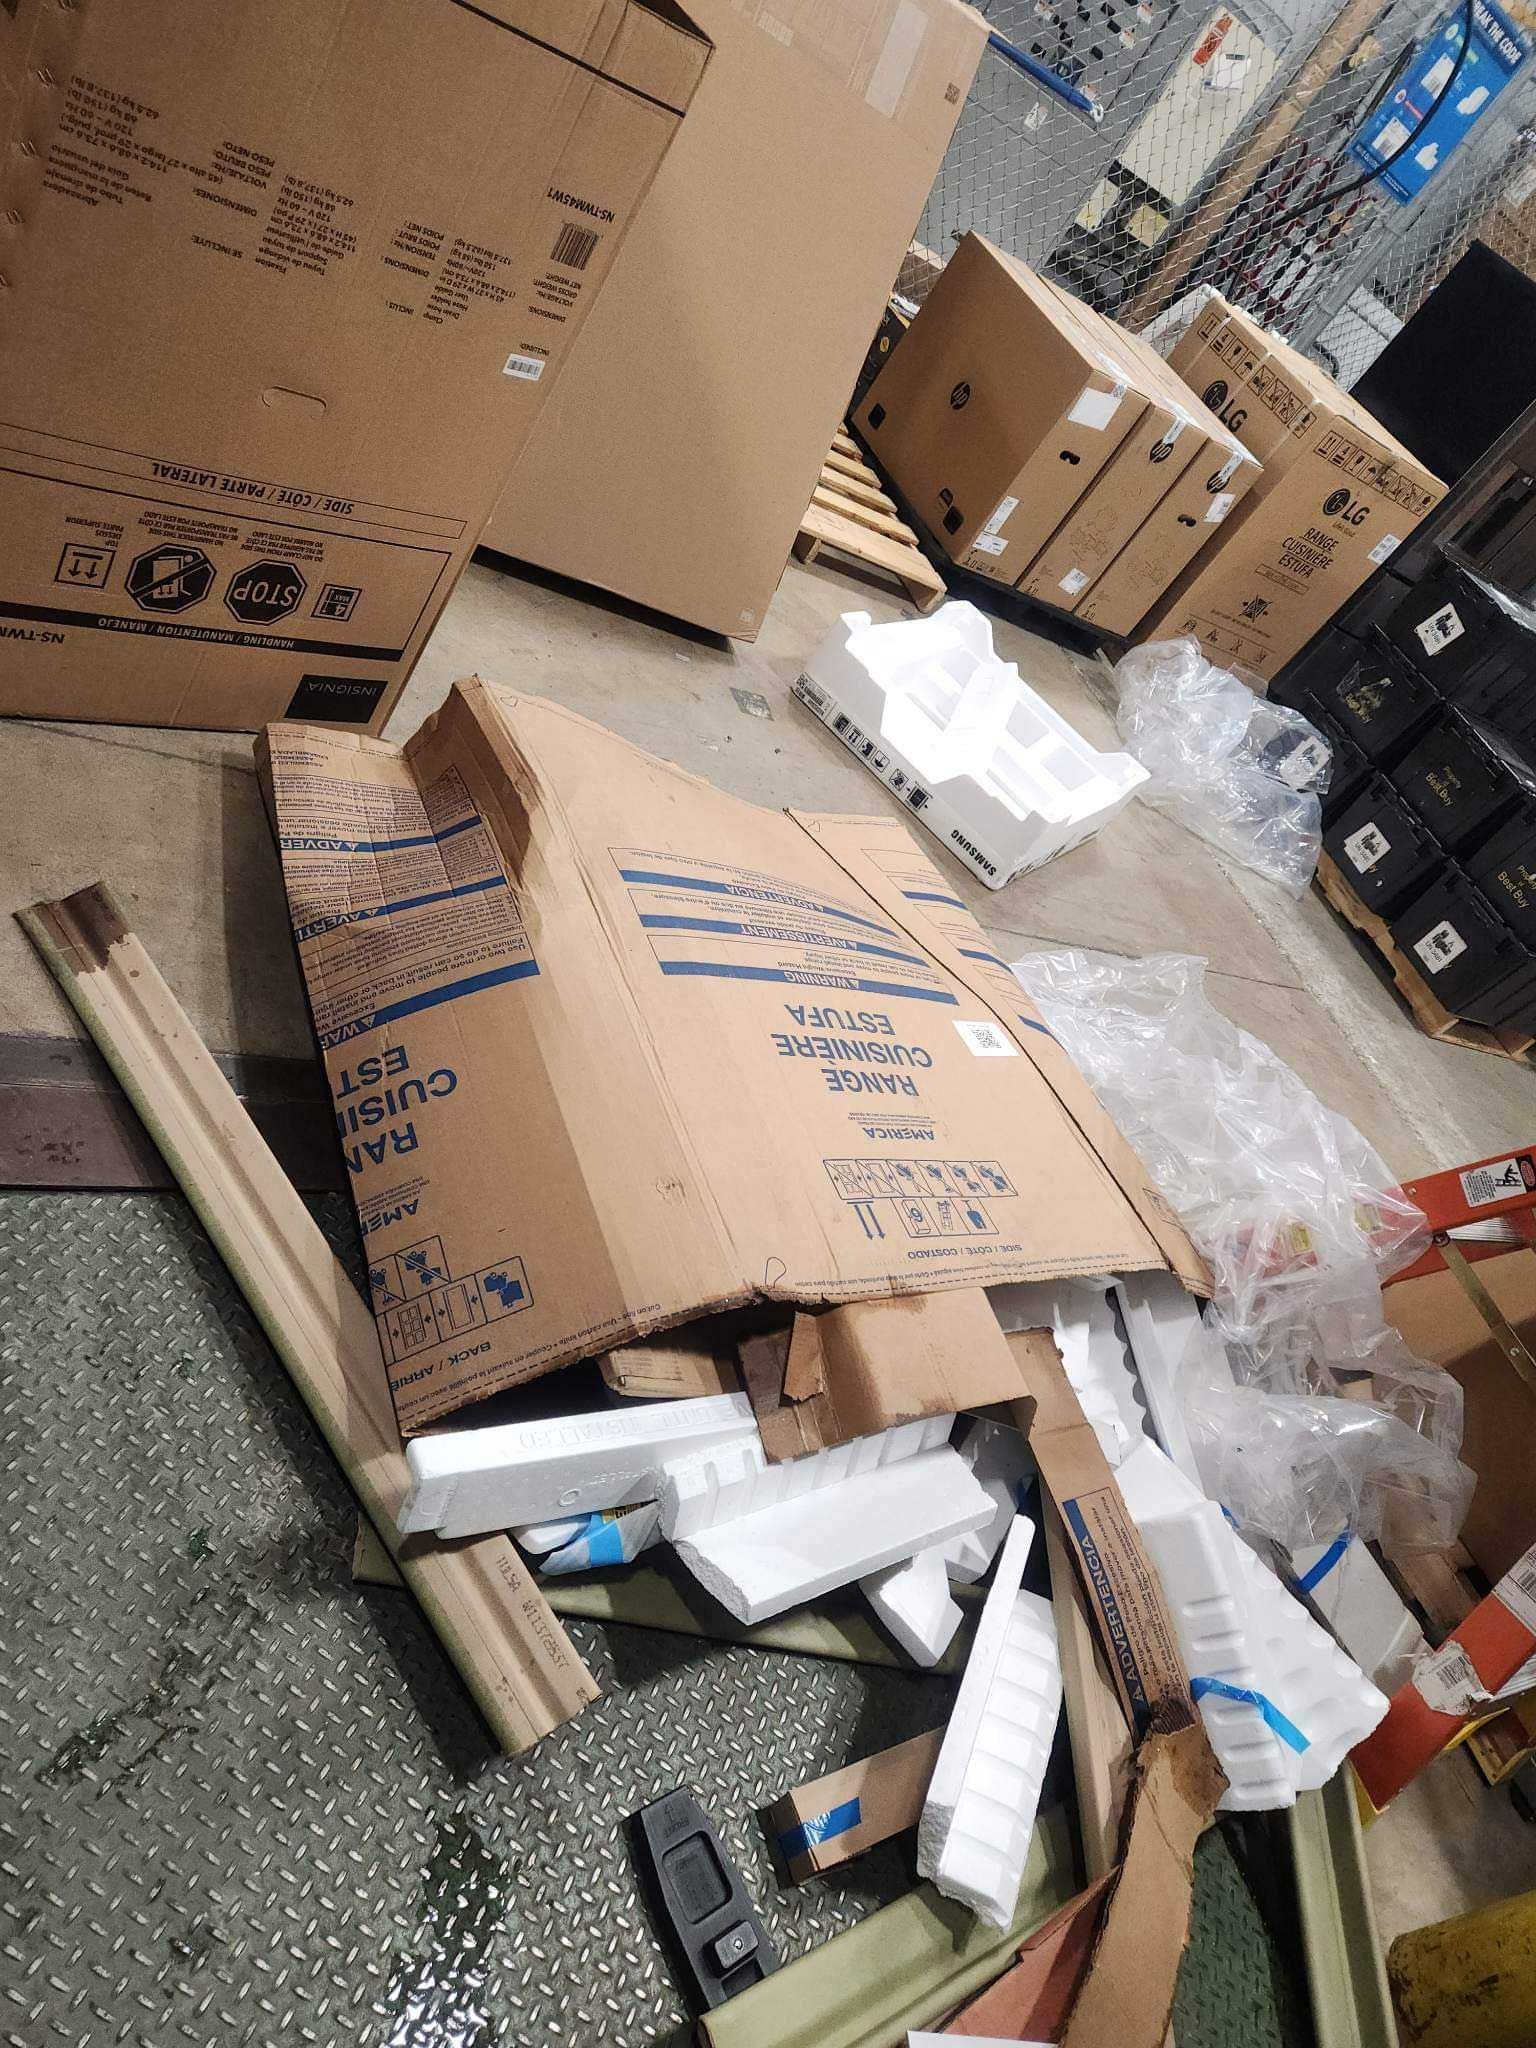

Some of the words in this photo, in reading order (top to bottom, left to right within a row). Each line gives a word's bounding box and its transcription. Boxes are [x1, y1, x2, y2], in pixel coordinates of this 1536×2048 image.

[1488, 22, 1505, 43] THE
[1499, 37, 1521, 65] CODE
[221, 140, 251, 157] NETO:
[210, 148, 247, 168] BRUTO:
[250, 151, 275, 166] PESO
[246, 162, 271, 178] PESO
[276, 196, 288, 206] Hz
[323, 188, 336, 200] kg
[191, 186, 257, 217] DIMENSIONES:
[312, 196, 324, 207] kg
[545, 186, 616, 222] NS-TWM45W1
[269, 215, 283, 224] cm
[314, 211, 331, 222] 120
[406, 221, 421, 231] NET
[397, 230, 417, 242] BRUT
[421, 227, 444, 240] POIDS
[190, 233, 230, 255] INCLUYE:
[417, 237, 440, 250] POIDS
[453, 237, 466, 248] kg)
[231, 248, 243, 258] SE
[449, 247, 461, 257] kg)
[483, 249, 493, 258] lbs
[253, 256, 287, 274] Fixation
[290, 257, 302, 267] de
[383, 255, 429, 277] DIMENSIONS
[473, 257, 483, 265] lbs
[441, 267, 454, 276] cm)
[544, 271, 569, 285] WEIGHT:
[434, 284, 453, 296] Guide
[532, 277, 557, 291] WEIGHT:
[569, 280, 581, 289] NET
[430, 293, 451, 305] holder
[454, 291, 469, 301] User
[557, 286, 577, 298] GROSS
[388, 301, 414, 315] INCLUS
[426, 303, 442, 313] hose
[451, 300, 468, 311] Hose
[422, 311, 444, 324] Clamp
[442, 308, 460, 319] Drain
[527, 304, 566, 323] DIMENSIONS:
[519, 341, 549, 357] INCLUDED:
[150, 463, 217, 488] LATERAL
[220, 478, 265, 497] PARTE
[277, 490, 311, 508] CÔTÉ
[323, 498, 353, 515] SIDE
[1341, 499, 1371, 526] LG
[64, 515, 101, 528] SUPERIOR
[103, 522, 123, 531] PARTE
[94, 529, 121, 539] DESSUS
[1303, 526, 1338, 552] RANGE
[105, 539, 118, 547] TOP
[1282, 537, 1333, 571] CUISINIÈRE
[1278, 553, 1315, 579] ESTUFA
[232, 575, 298, 607] STOP
[333, 593, 350, 602] MAX
[334, 604, 346, 615] 4
[97, 617, 145, 631] MANEJO
[157, 623, 234, 642] MANUTENTION
[242, 634, 294, 648] HANDLING
[307, 679, 376, 698] INSIGNIA
[280, 839, 342, 850] ADVER
[951, 829, 997, 877] SAMSUNG
[724, 883, 814, 910] ADVERTENCIA
[1497, 871, 1517, 892] Best
[1510, 889, 1531, 910] Buy
[491, 934, 523, 951] Failure
[739, 924, 847, 951] AVERTISSEMENT
[466, 949, 478, 958] do
[479, 944, 490, 953] to
[487, 947, 505, 959] two
[506, 941, 525, 953] Use
[433, 957, 452, 969] can
[450, 957, 474, 971] more
[452, 952, 465, 962] so
[475, 953, 486, 962] or
[404, 963, 433, 979] result
[776, 959, 801, 970] Hazard
[416, 964, 449, 983] people
[784, 970, 848, 989] WARNING
[370, 977, 395, 992] back
[378, 981, 404, 996] move
[405, 977, 415, 986] to
[333, 991, 359, 1006] other
[358, 992, 377, 1004] and
[359, 987, 371, 996] or
[329, 1002, 376, 1024] Excessive
[330, 999, 359, 1015] install
[784, 1004, 896, 1035] ESTUFA
[771, 1033, 933, 1068] CUISINIÈRE
[336, 1045, 410, 1099] EST
[821, 1069, 919, 1096] RANGE
[862, 1127, 935, 1140] AMERICA
[346, 1122, 419, 1173] RAN
[907, 1247, 957, 1259] COSTADO
[965, 1245, 992, 1254] CÔTÉ
[1001, 1243, 1021, 1251] SIDE
[647, 1302, 661, 1314] Cut
[576, 1323, 602, 1339] carton
[557, 1333, 577, 1347] knife
[447, 1340, 492, 1366] BACK
[524, 1340, 552, 1359] Couper
[486, 1358, 513, 1375] suivant
[429, 1385, 448, 1398] avec
[1099, 1495, 1111, 1514] una
[1089, 1506, 1110, 1541] instalar
[1107, 1514, 1132, 1561] ocasionar
[1109, 1550, 1127, 1580] mover
[1127, 1561, 1146, 1592] puede
[1120, 1581, 1137, 1606] para
[1081, 1535, 1142, 1682] ADVERTENCIA
[1117, 1597, 1134, 1623] Peso
[1127, 1606, 1154, 1653] personas
[1127, 1624, 1138, 1638] de
[1130, 1640, 1153, 1675] Peligro
[1158, 1650, 1172, 1671] esta
[1145, 1654, 1160, 1676] más
